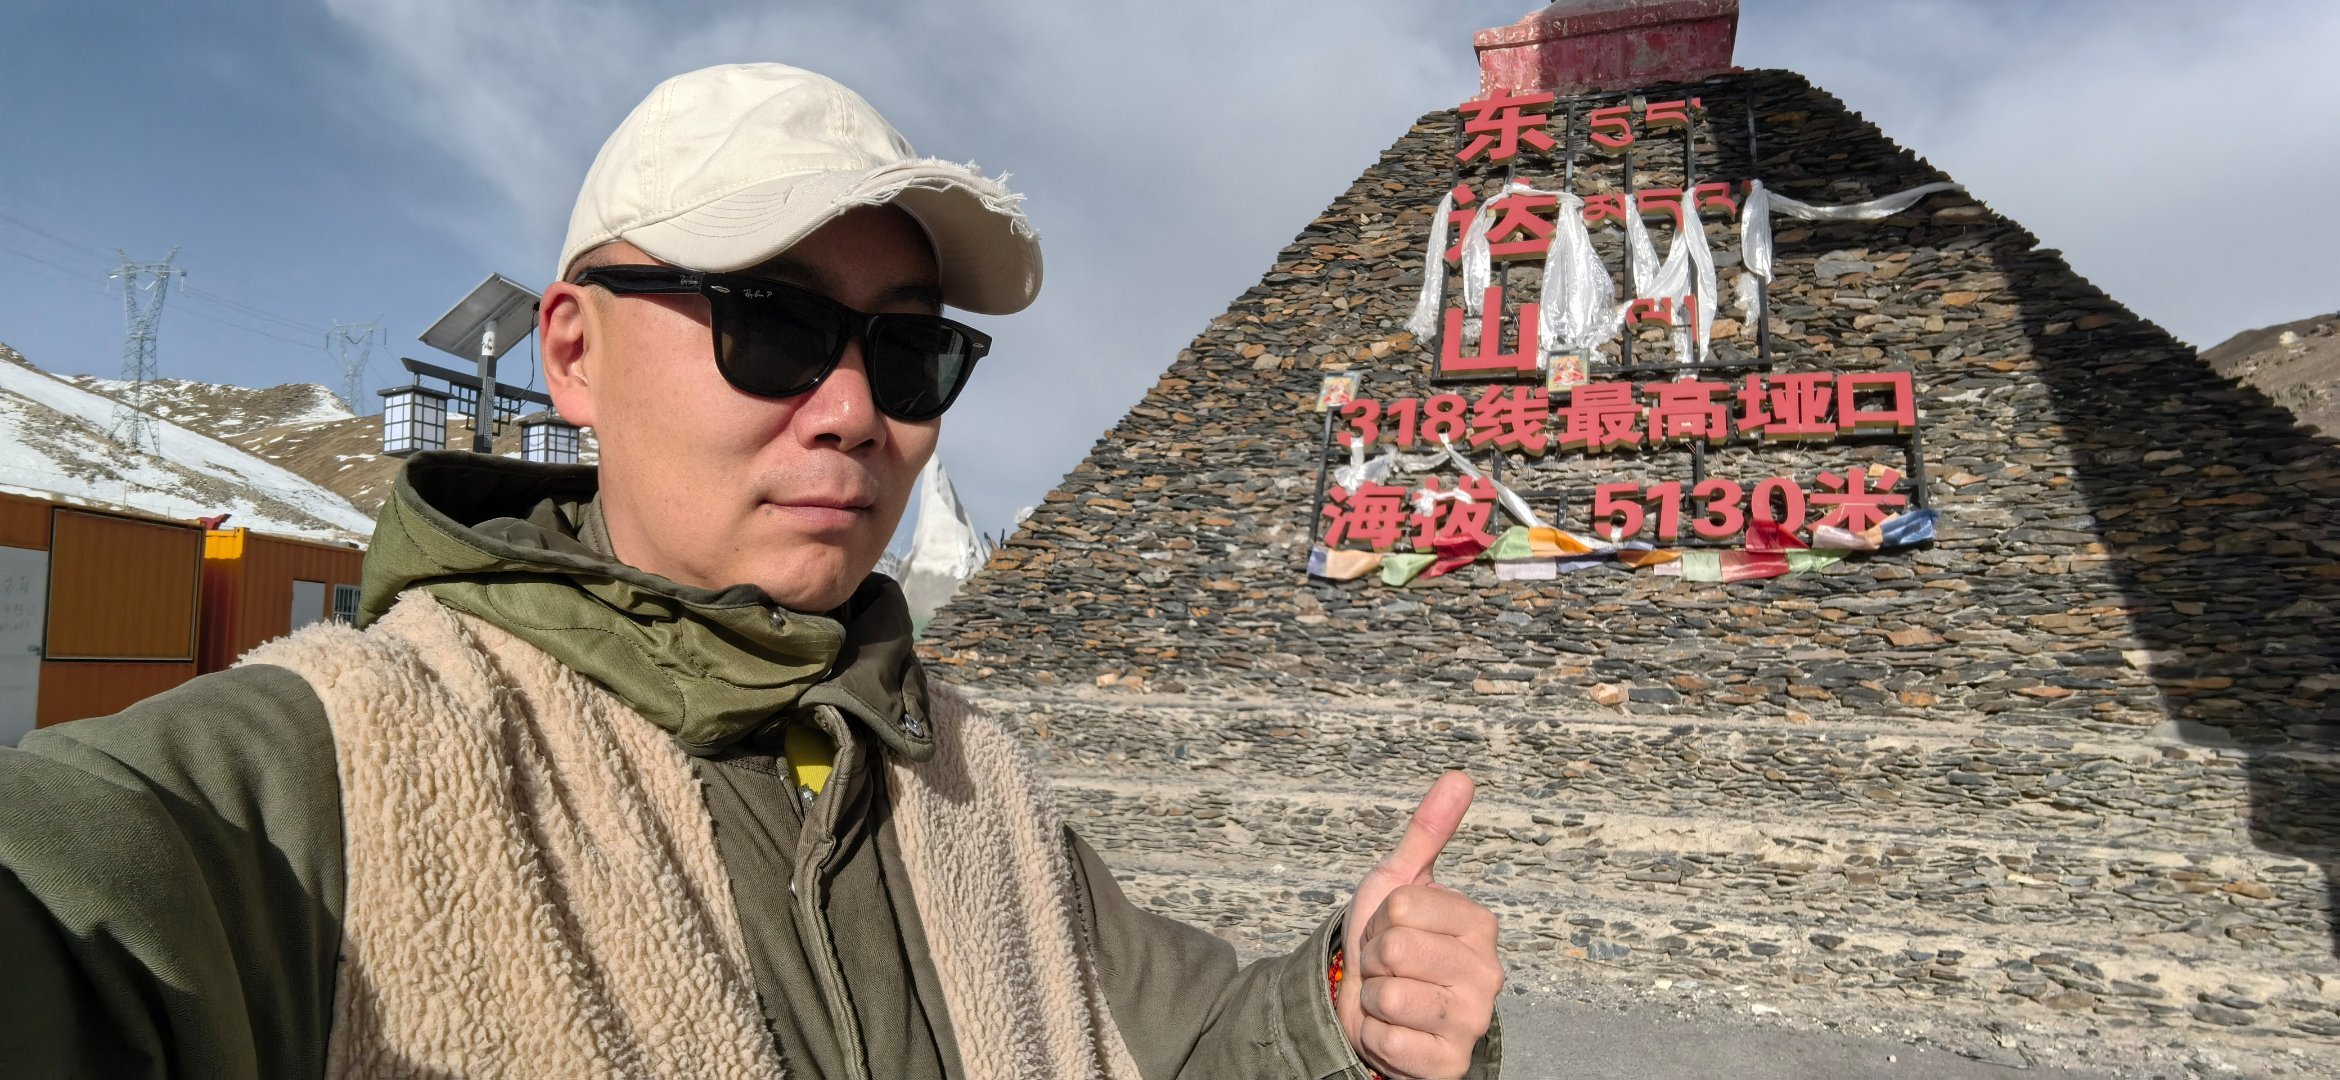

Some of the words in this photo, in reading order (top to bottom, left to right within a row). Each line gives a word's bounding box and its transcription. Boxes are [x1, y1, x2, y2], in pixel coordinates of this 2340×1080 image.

[1441, 88, 1557, 372] 东达山
[1337, 371, 1916, 454] 318线最高垭口
[1322, 475, 1498, 552] 海拔
[1594, 467, 1906, 541] 5130米
